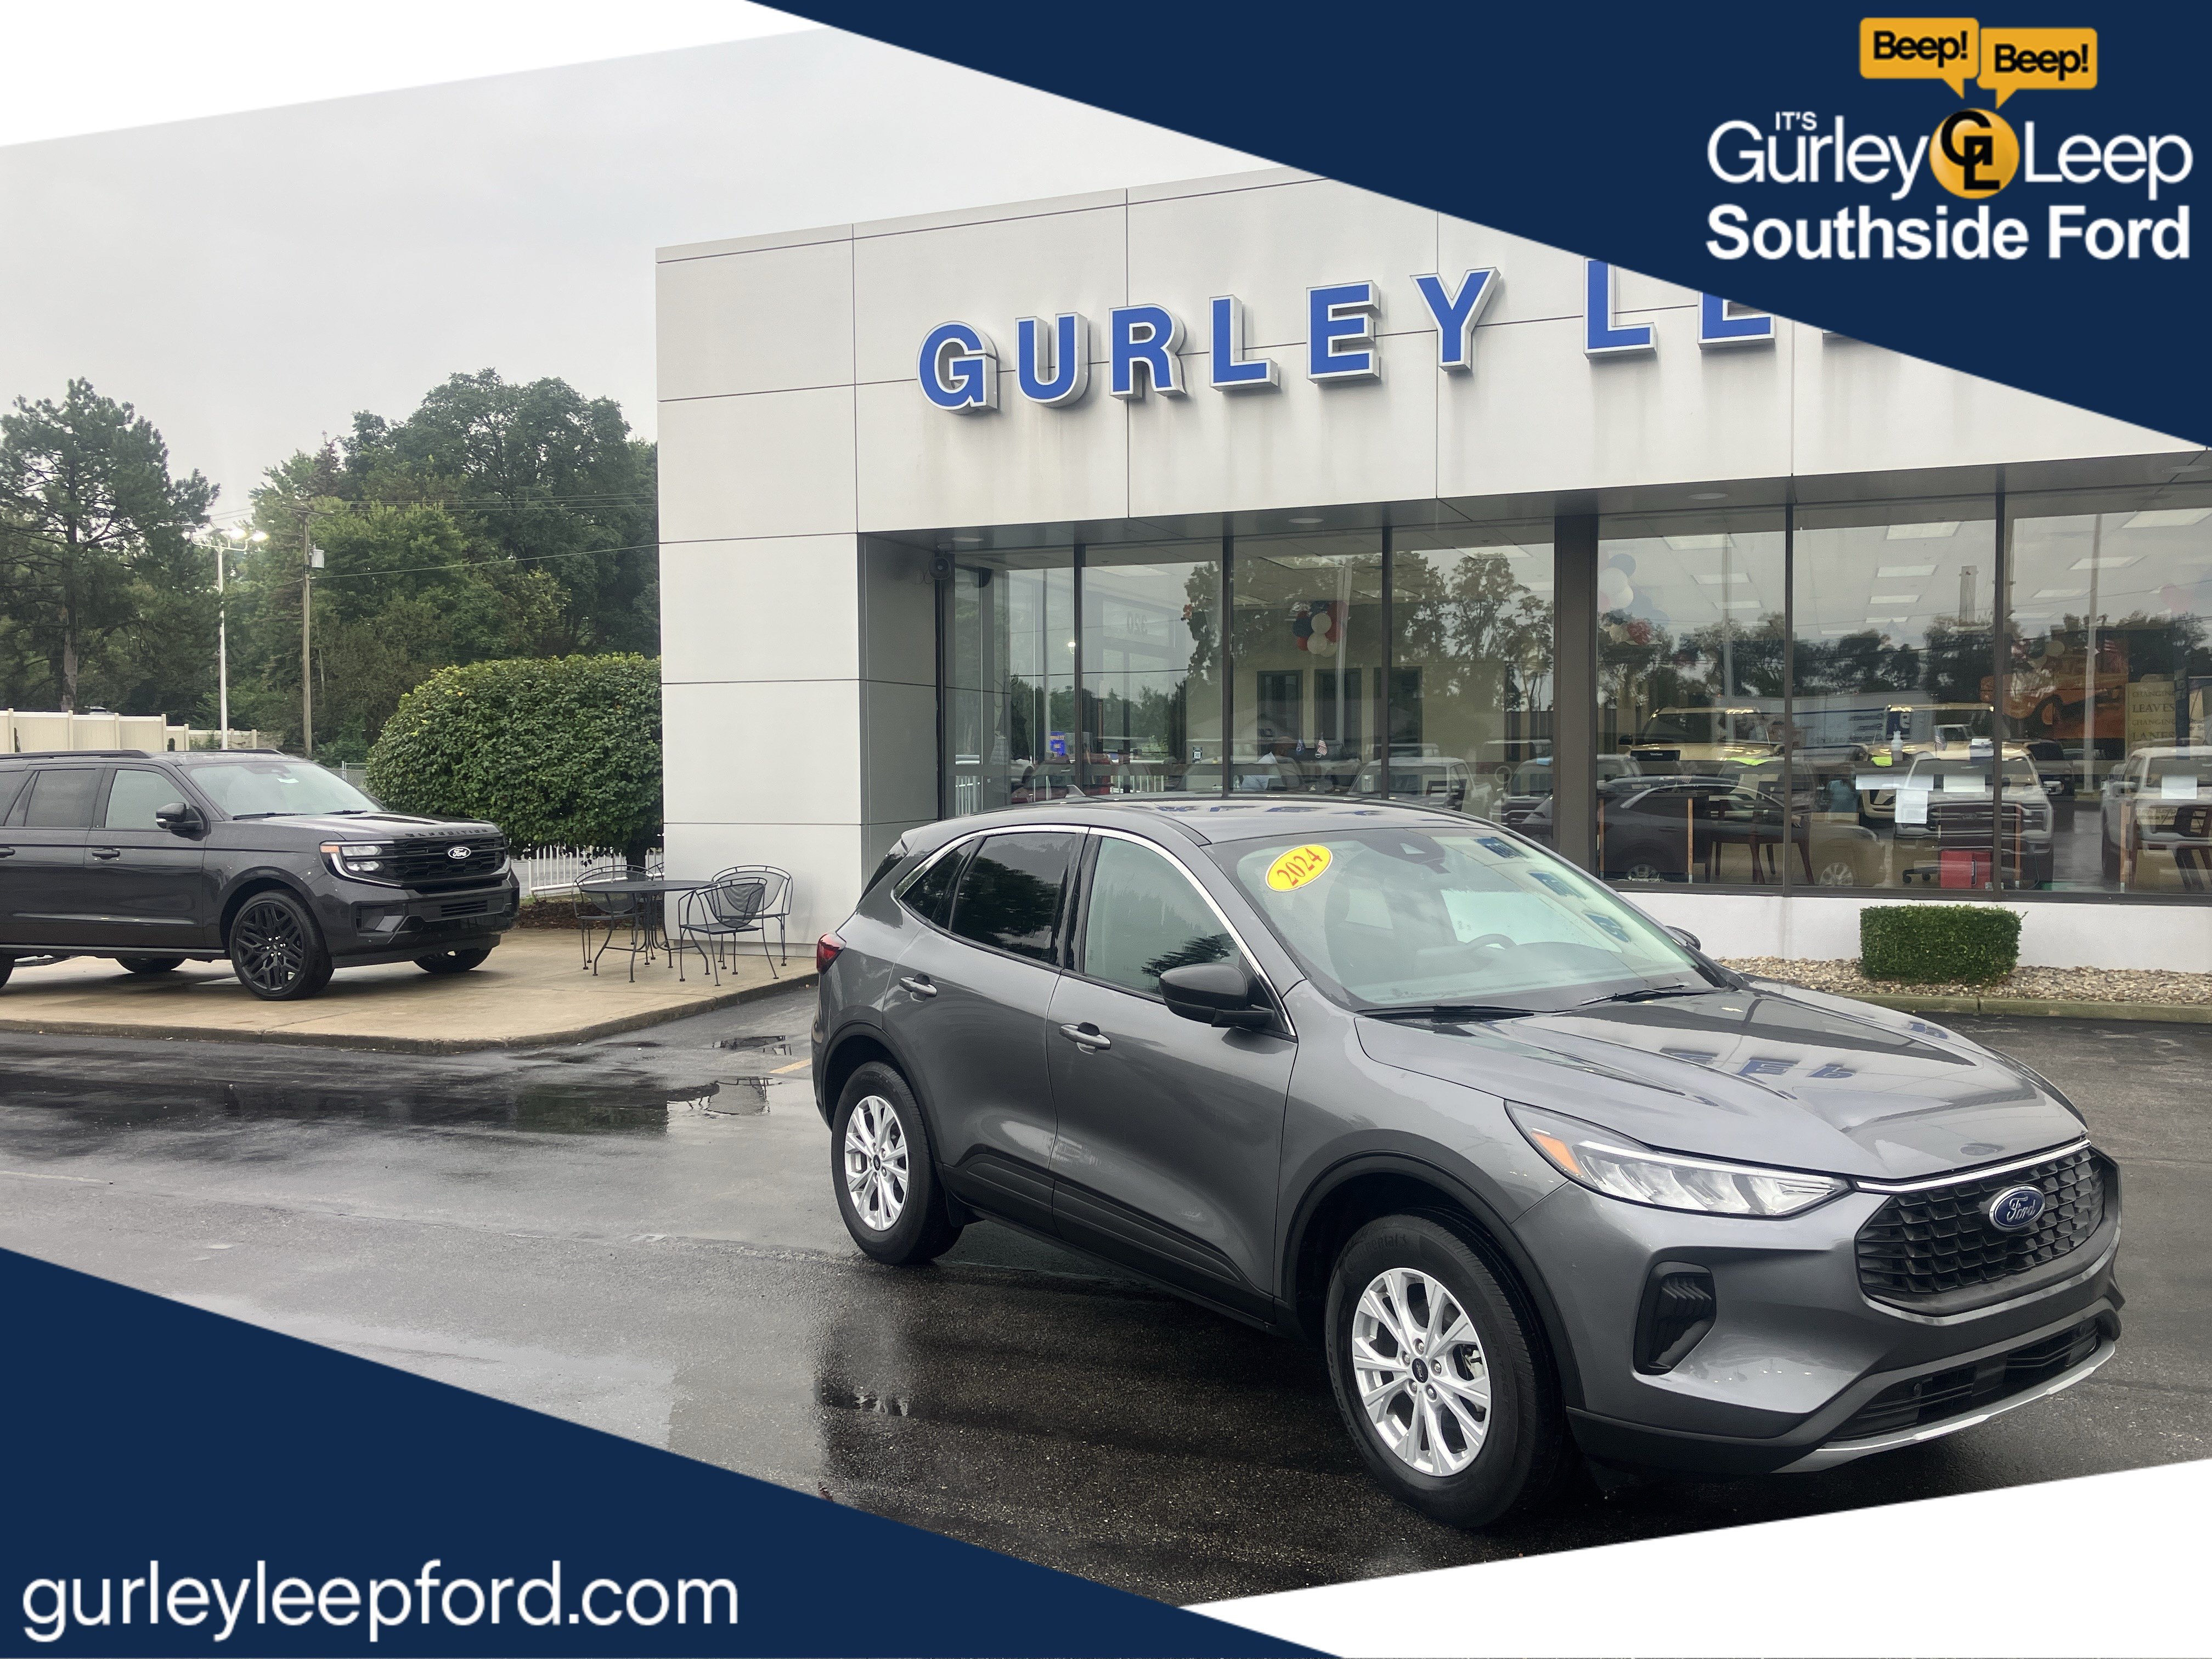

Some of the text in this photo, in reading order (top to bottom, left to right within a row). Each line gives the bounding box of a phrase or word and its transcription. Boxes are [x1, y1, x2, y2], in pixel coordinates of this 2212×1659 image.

[917, 266, 1501, 415] GURLEY
[2132, 703, 2175, 713] LEAVES
[452, 848, 467, 857] Ford
[1277, 848, 1323, 886] 2024
[2006, 1196, 2036, 1223] Ford
